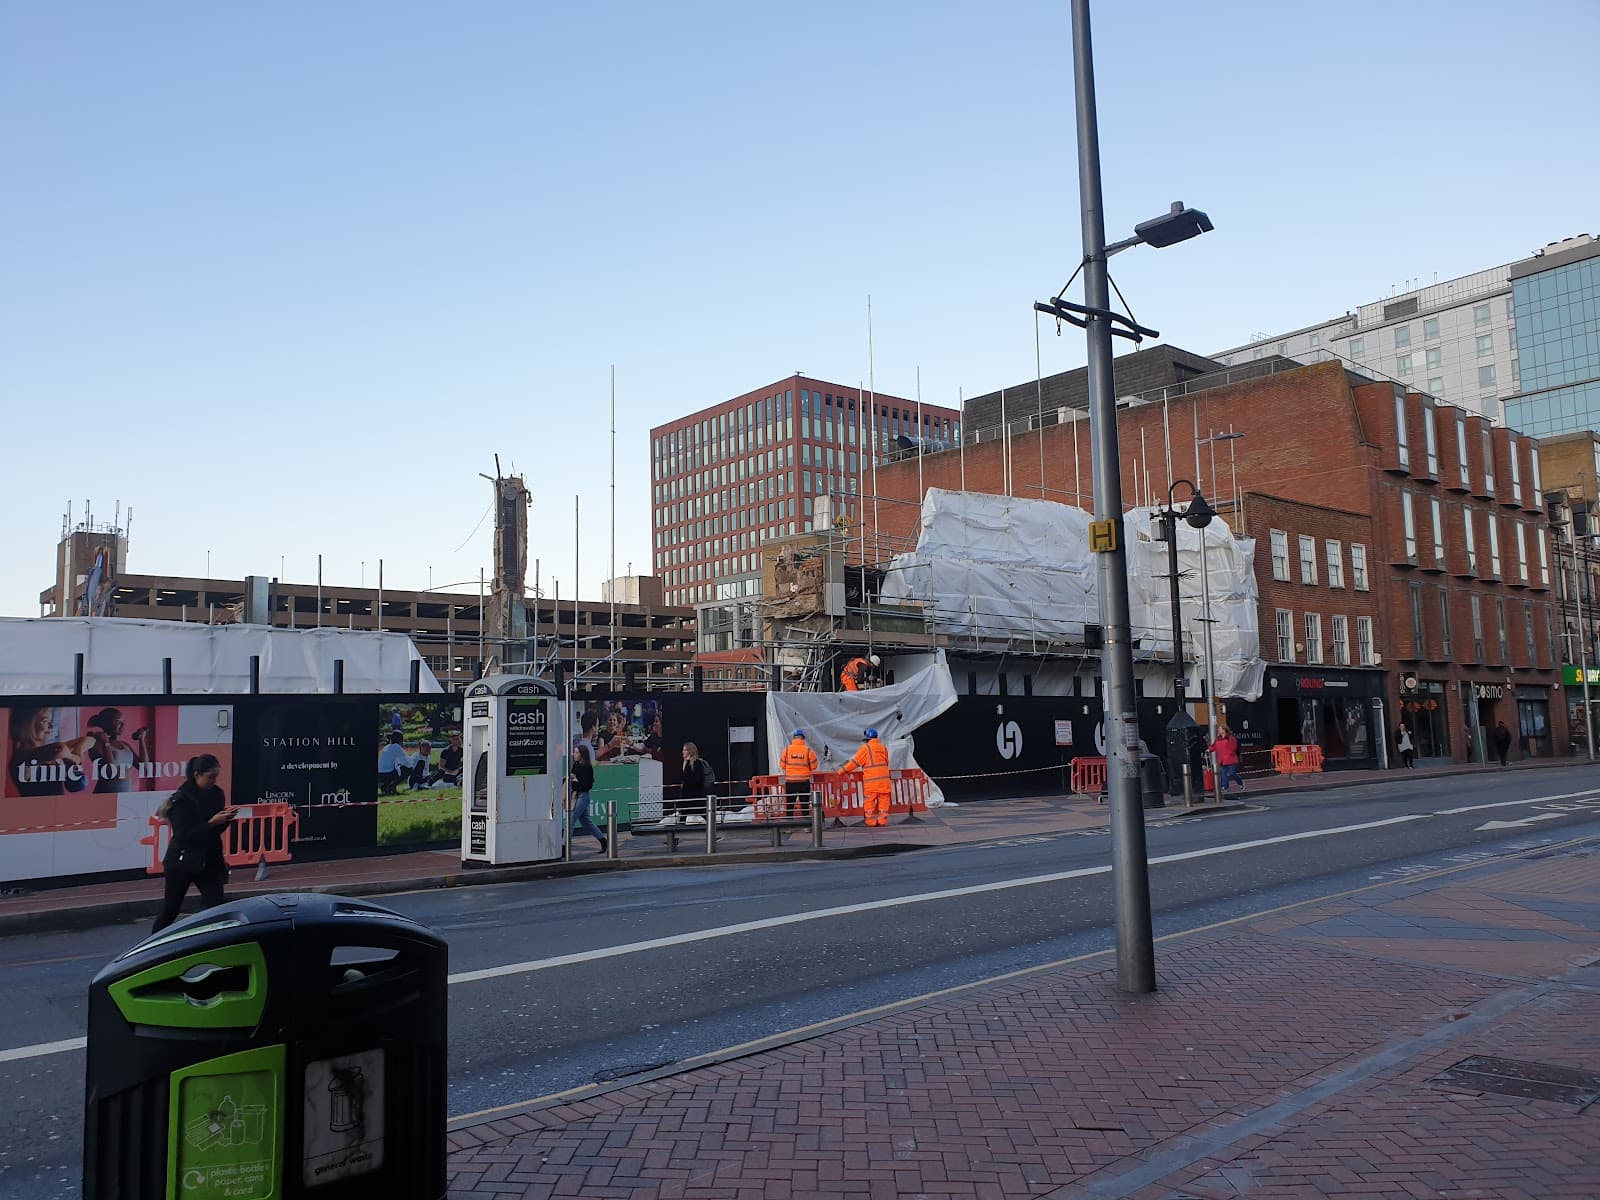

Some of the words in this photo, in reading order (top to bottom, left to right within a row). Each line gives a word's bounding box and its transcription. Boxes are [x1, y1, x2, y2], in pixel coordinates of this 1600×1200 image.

[1092, 522, 1112, 549] H
[1576, 668, 1600, 682] SUWAY
[517, 685, 540, 694] cash
[509, 708, 545, 724] cash
[263, 737, 320, 747] STATION
[327, 736, 356, 746] HILL
[17, 758, 84, 783] time
[91, 757, 134, 781] for
[138, 761, 188, 779] mor
[286, 761, 330, 771] development
[265, 791, 295, 799] LINCOLN
[321, 789, 351, 809] mgt
[471, 819, 486, 830] cash
[233, 1184, 253, 1196] card
